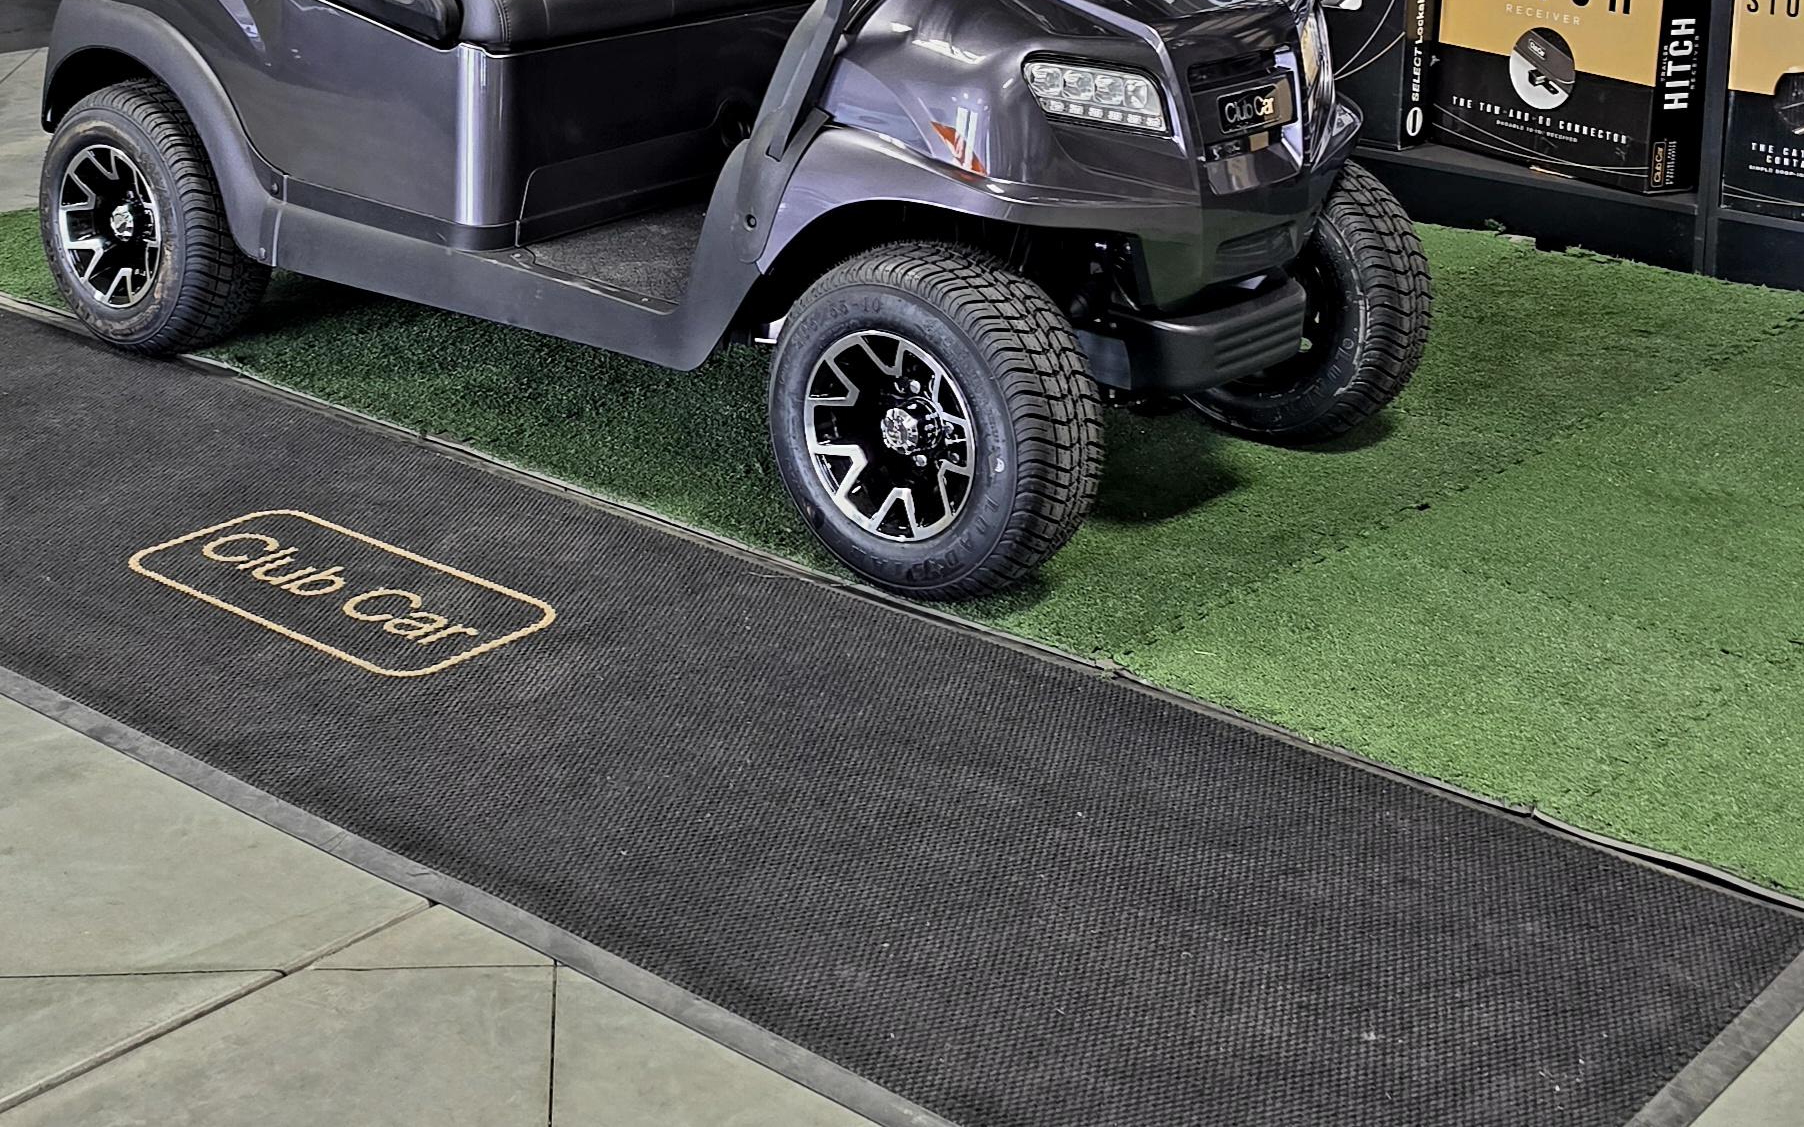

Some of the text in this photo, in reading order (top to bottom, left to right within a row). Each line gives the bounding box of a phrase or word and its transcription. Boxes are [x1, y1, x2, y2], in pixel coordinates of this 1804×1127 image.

[1506, 3, 1581, 26] RECEIVER
[1411, 46, 1423, 102] SELECT
[1663, 13, 1697, 110] HITCH
[1225, 95, 1275, 123] Club Car
[1452, 95, 1473, 109] THE
[1559, 120, 1628, 145] CONNECTOR
[1751, 142, 1775, 154] THE
[201, 532, 479, 646] Club Car
